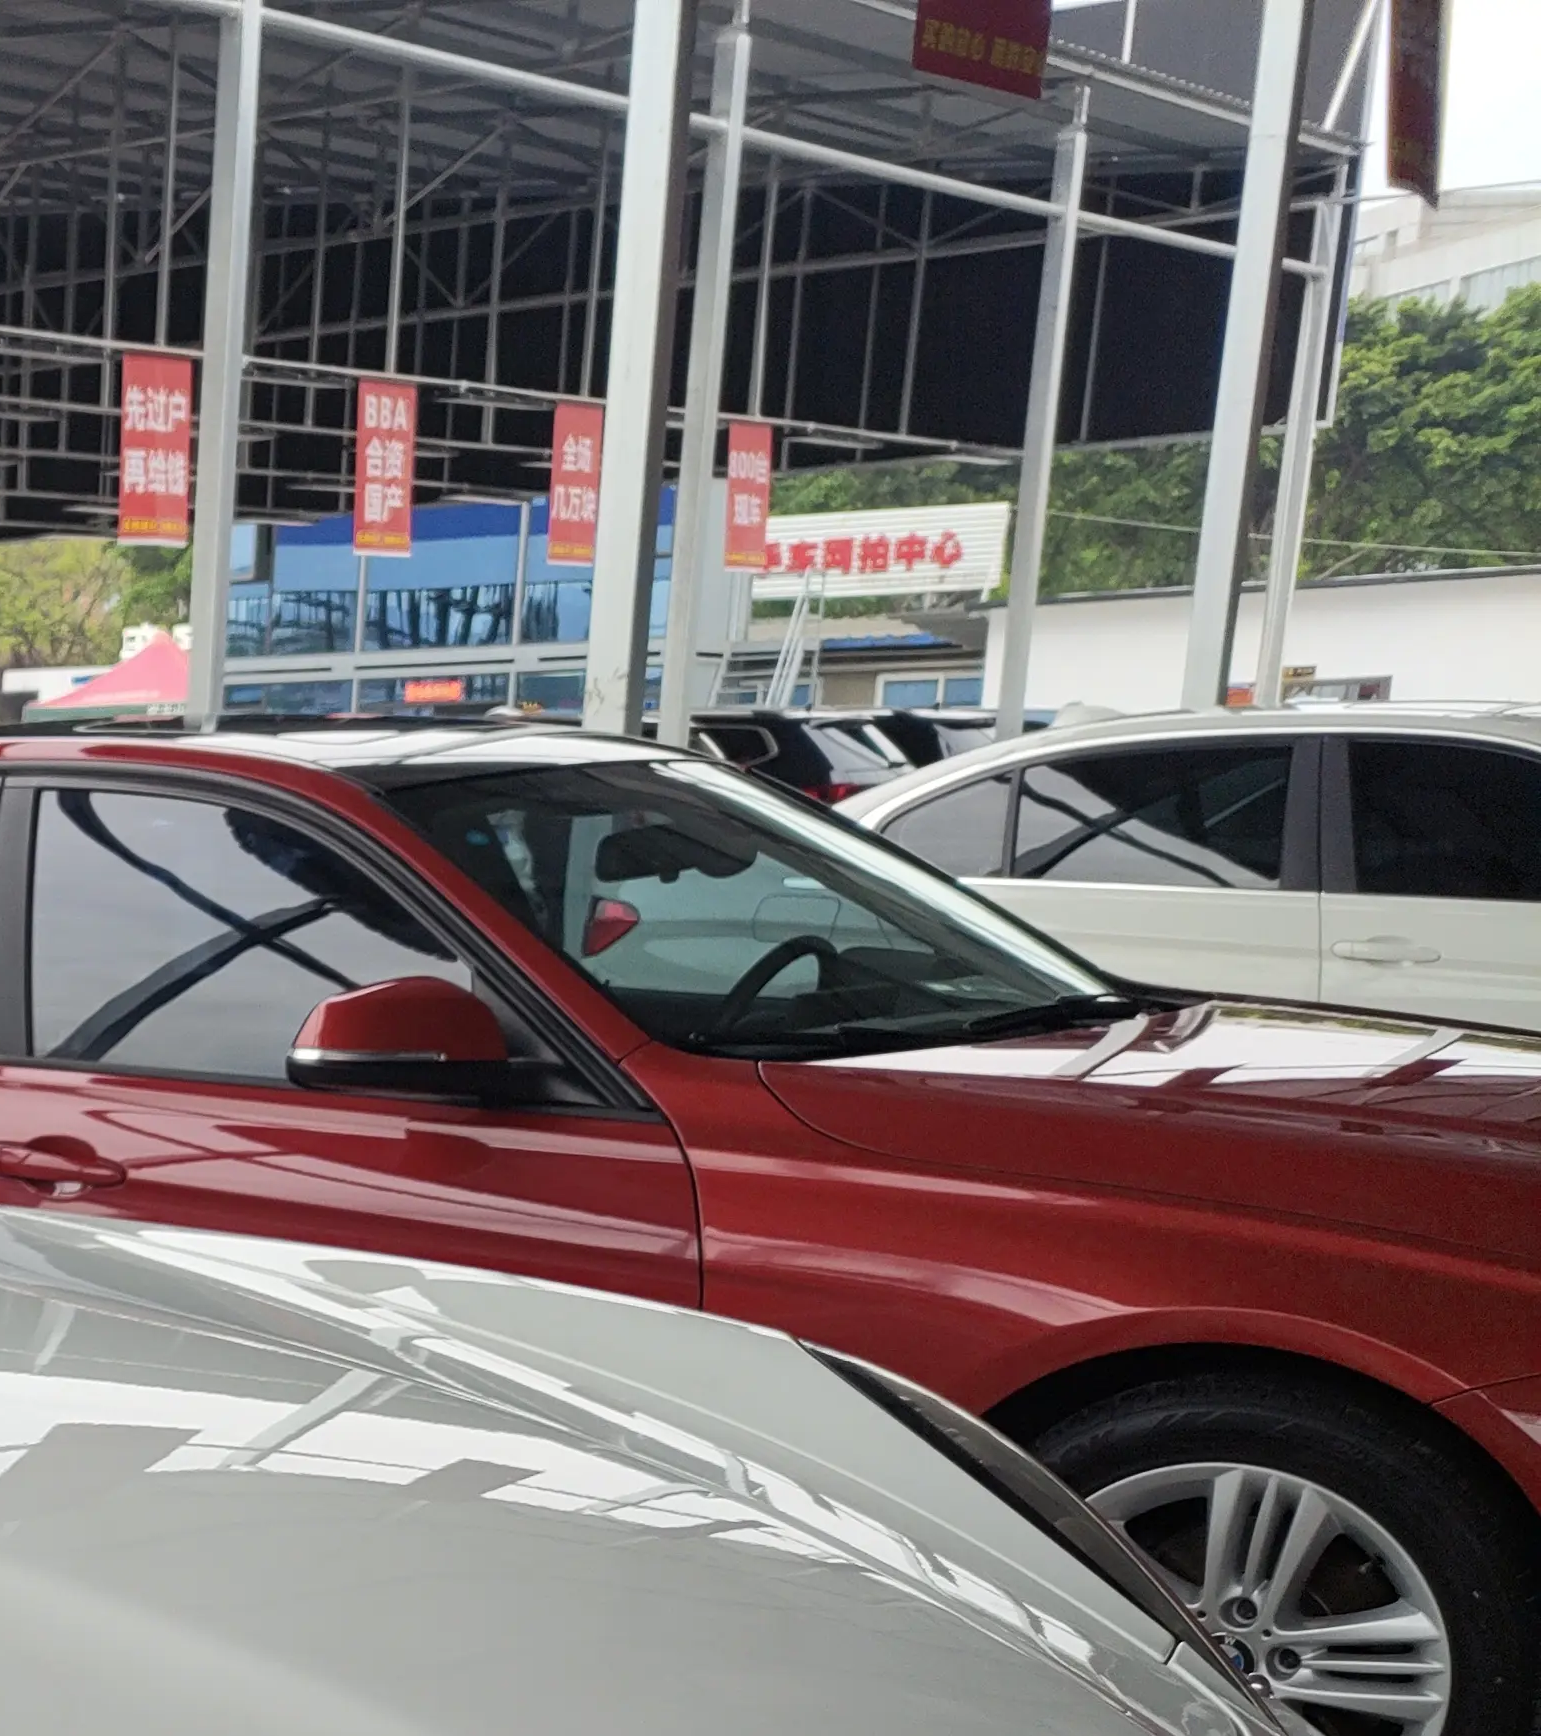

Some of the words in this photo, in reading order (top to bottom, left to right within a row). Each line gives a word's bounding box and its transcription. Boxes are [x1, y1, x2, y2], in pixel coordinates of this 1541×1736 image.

[124, 383, 186, 433] 先过户
[364, 394, 409, 431] BBA
[365, 437, 405, 479] 合资
[363, 483, 404, 524] 国产
